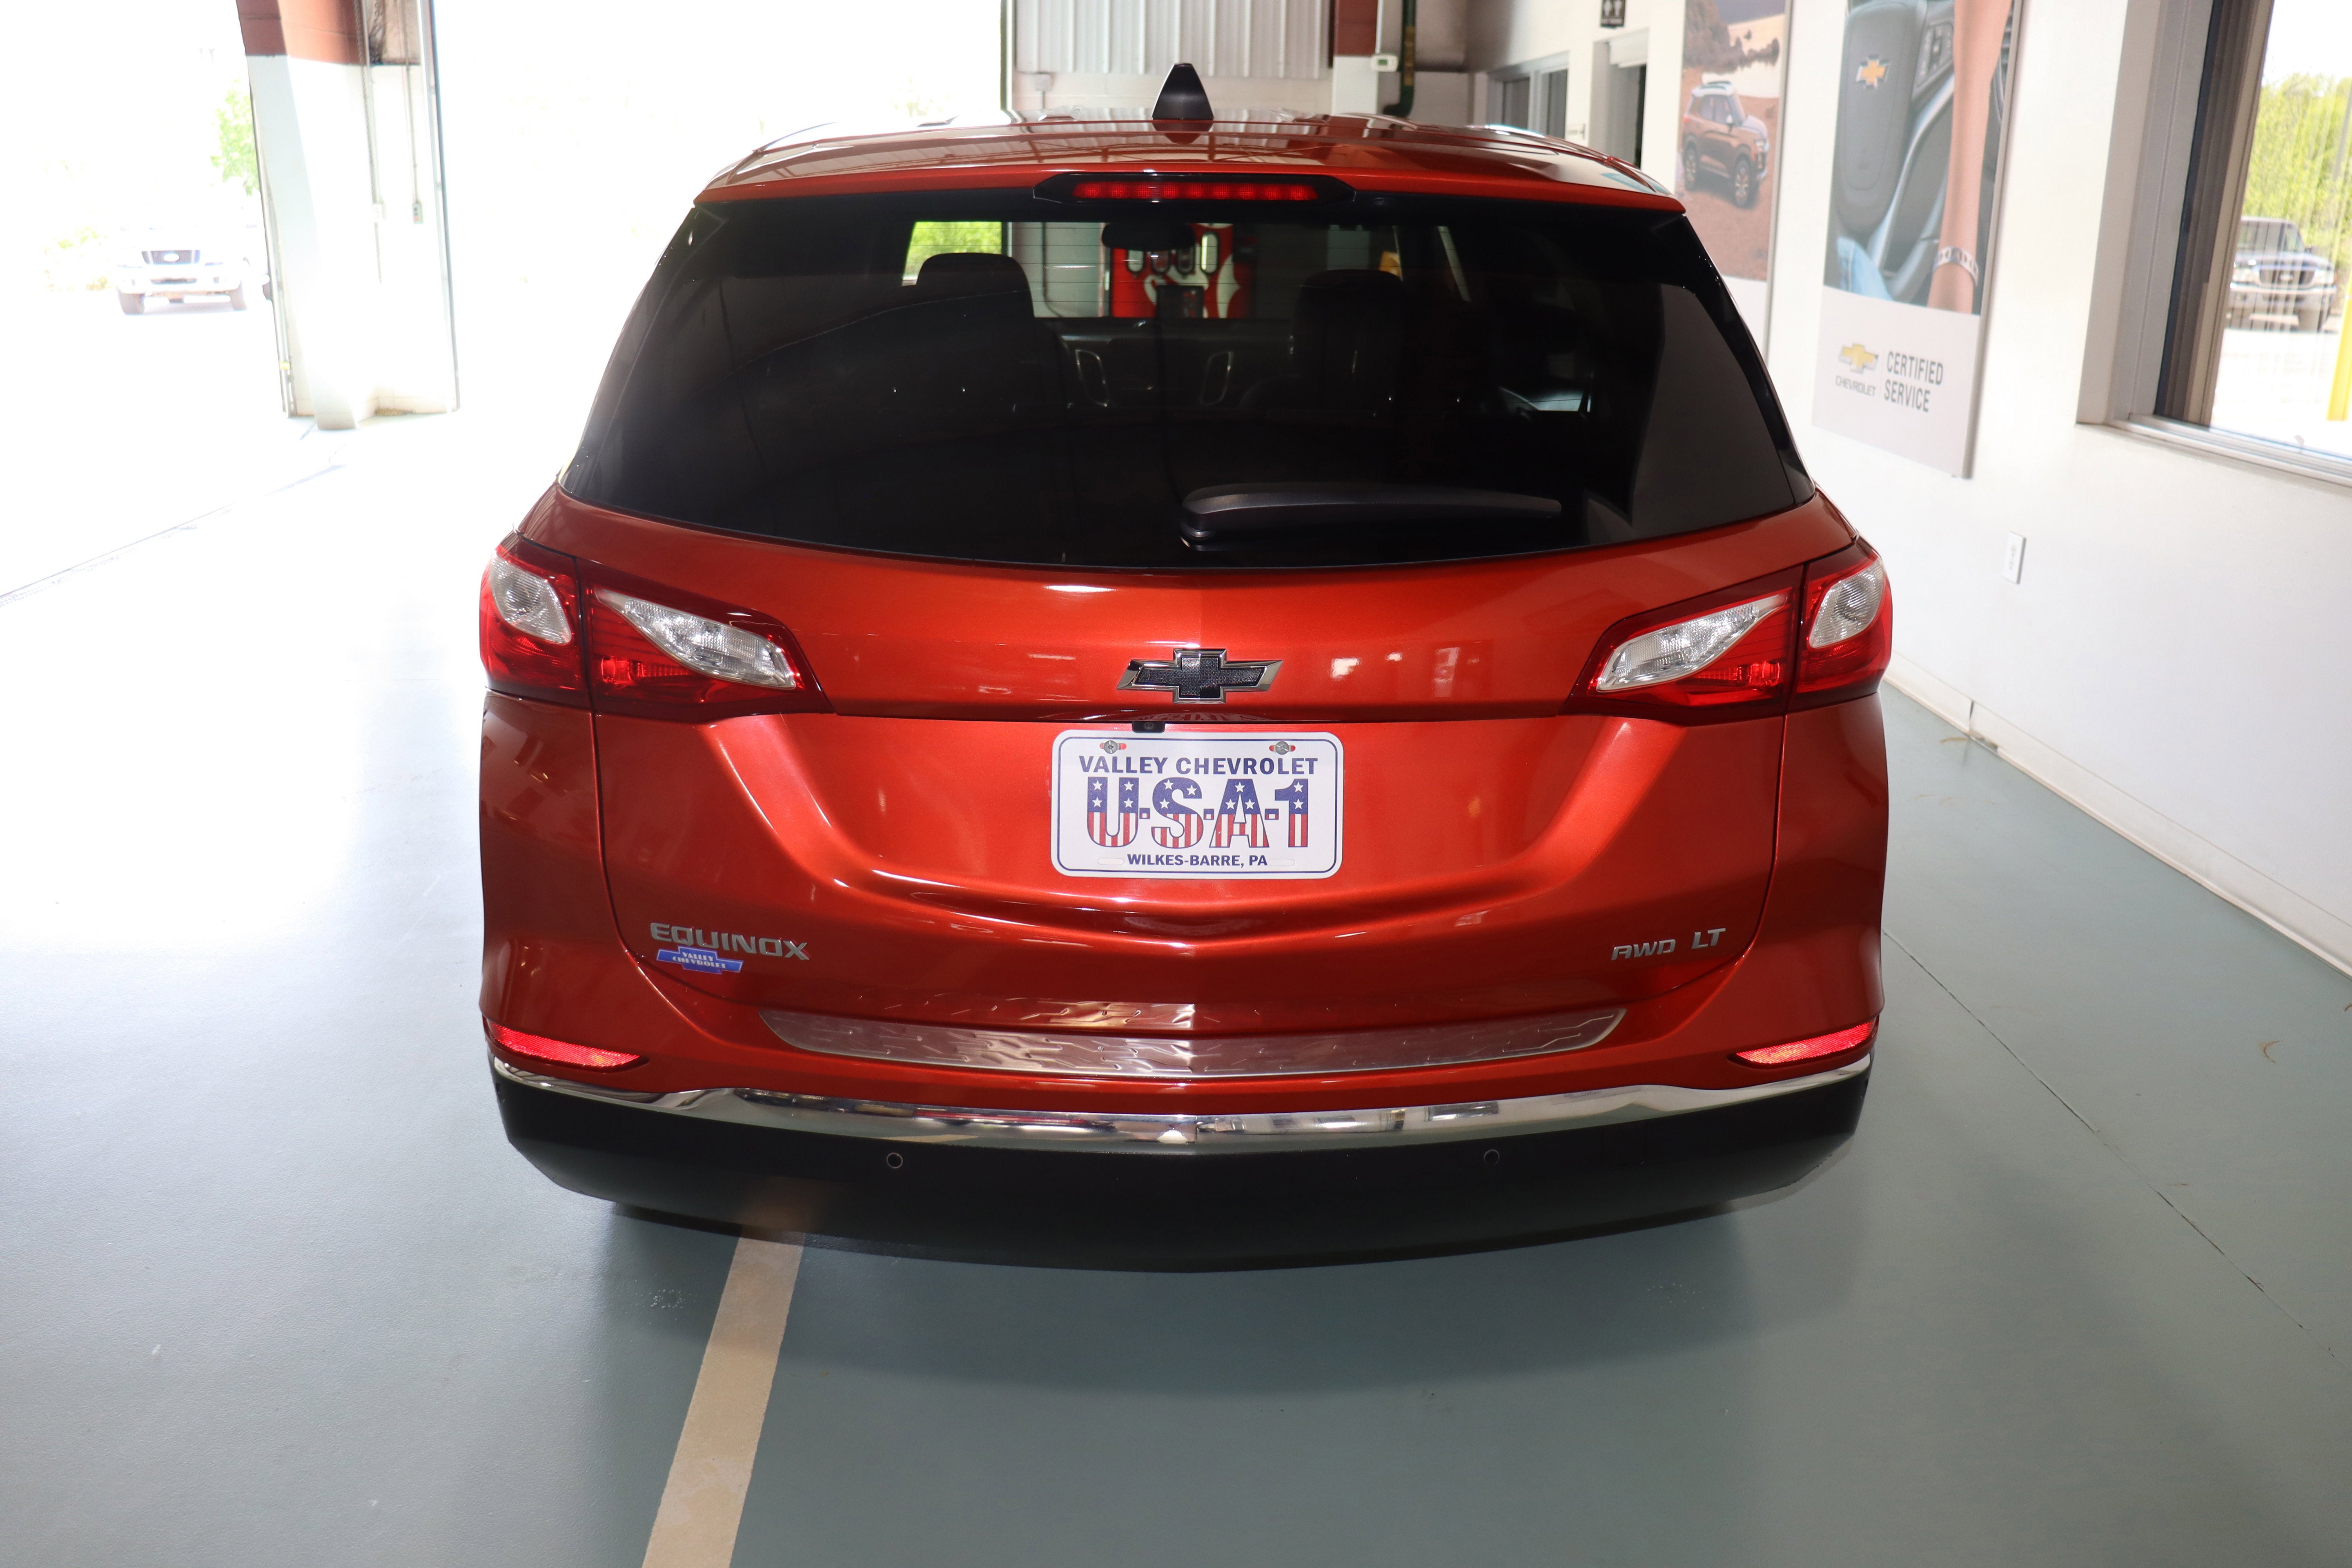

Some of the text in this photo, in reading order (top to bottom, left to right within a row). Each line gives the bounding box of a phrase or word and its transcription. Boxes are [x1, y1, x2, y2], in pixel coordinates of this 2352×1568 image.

[1886, 351, 1944, 385] CERTIFIED
[1835, 375, 1876, 396] CHEVROLET
[1884, 379, 1931, 412] SERVICE
[1079, 755, 1318, 775] VALLEY CHEVROLET
[1127, 854, 1268, 868] WILKES-BARRE, PA
[650, 922, 809, 960] EQUINOX
[1611, 928, 1726, 960] AWD LT
[673, 956, 726, 969] CHEVROLET
[682, 952, 713, 961] VALLEY
